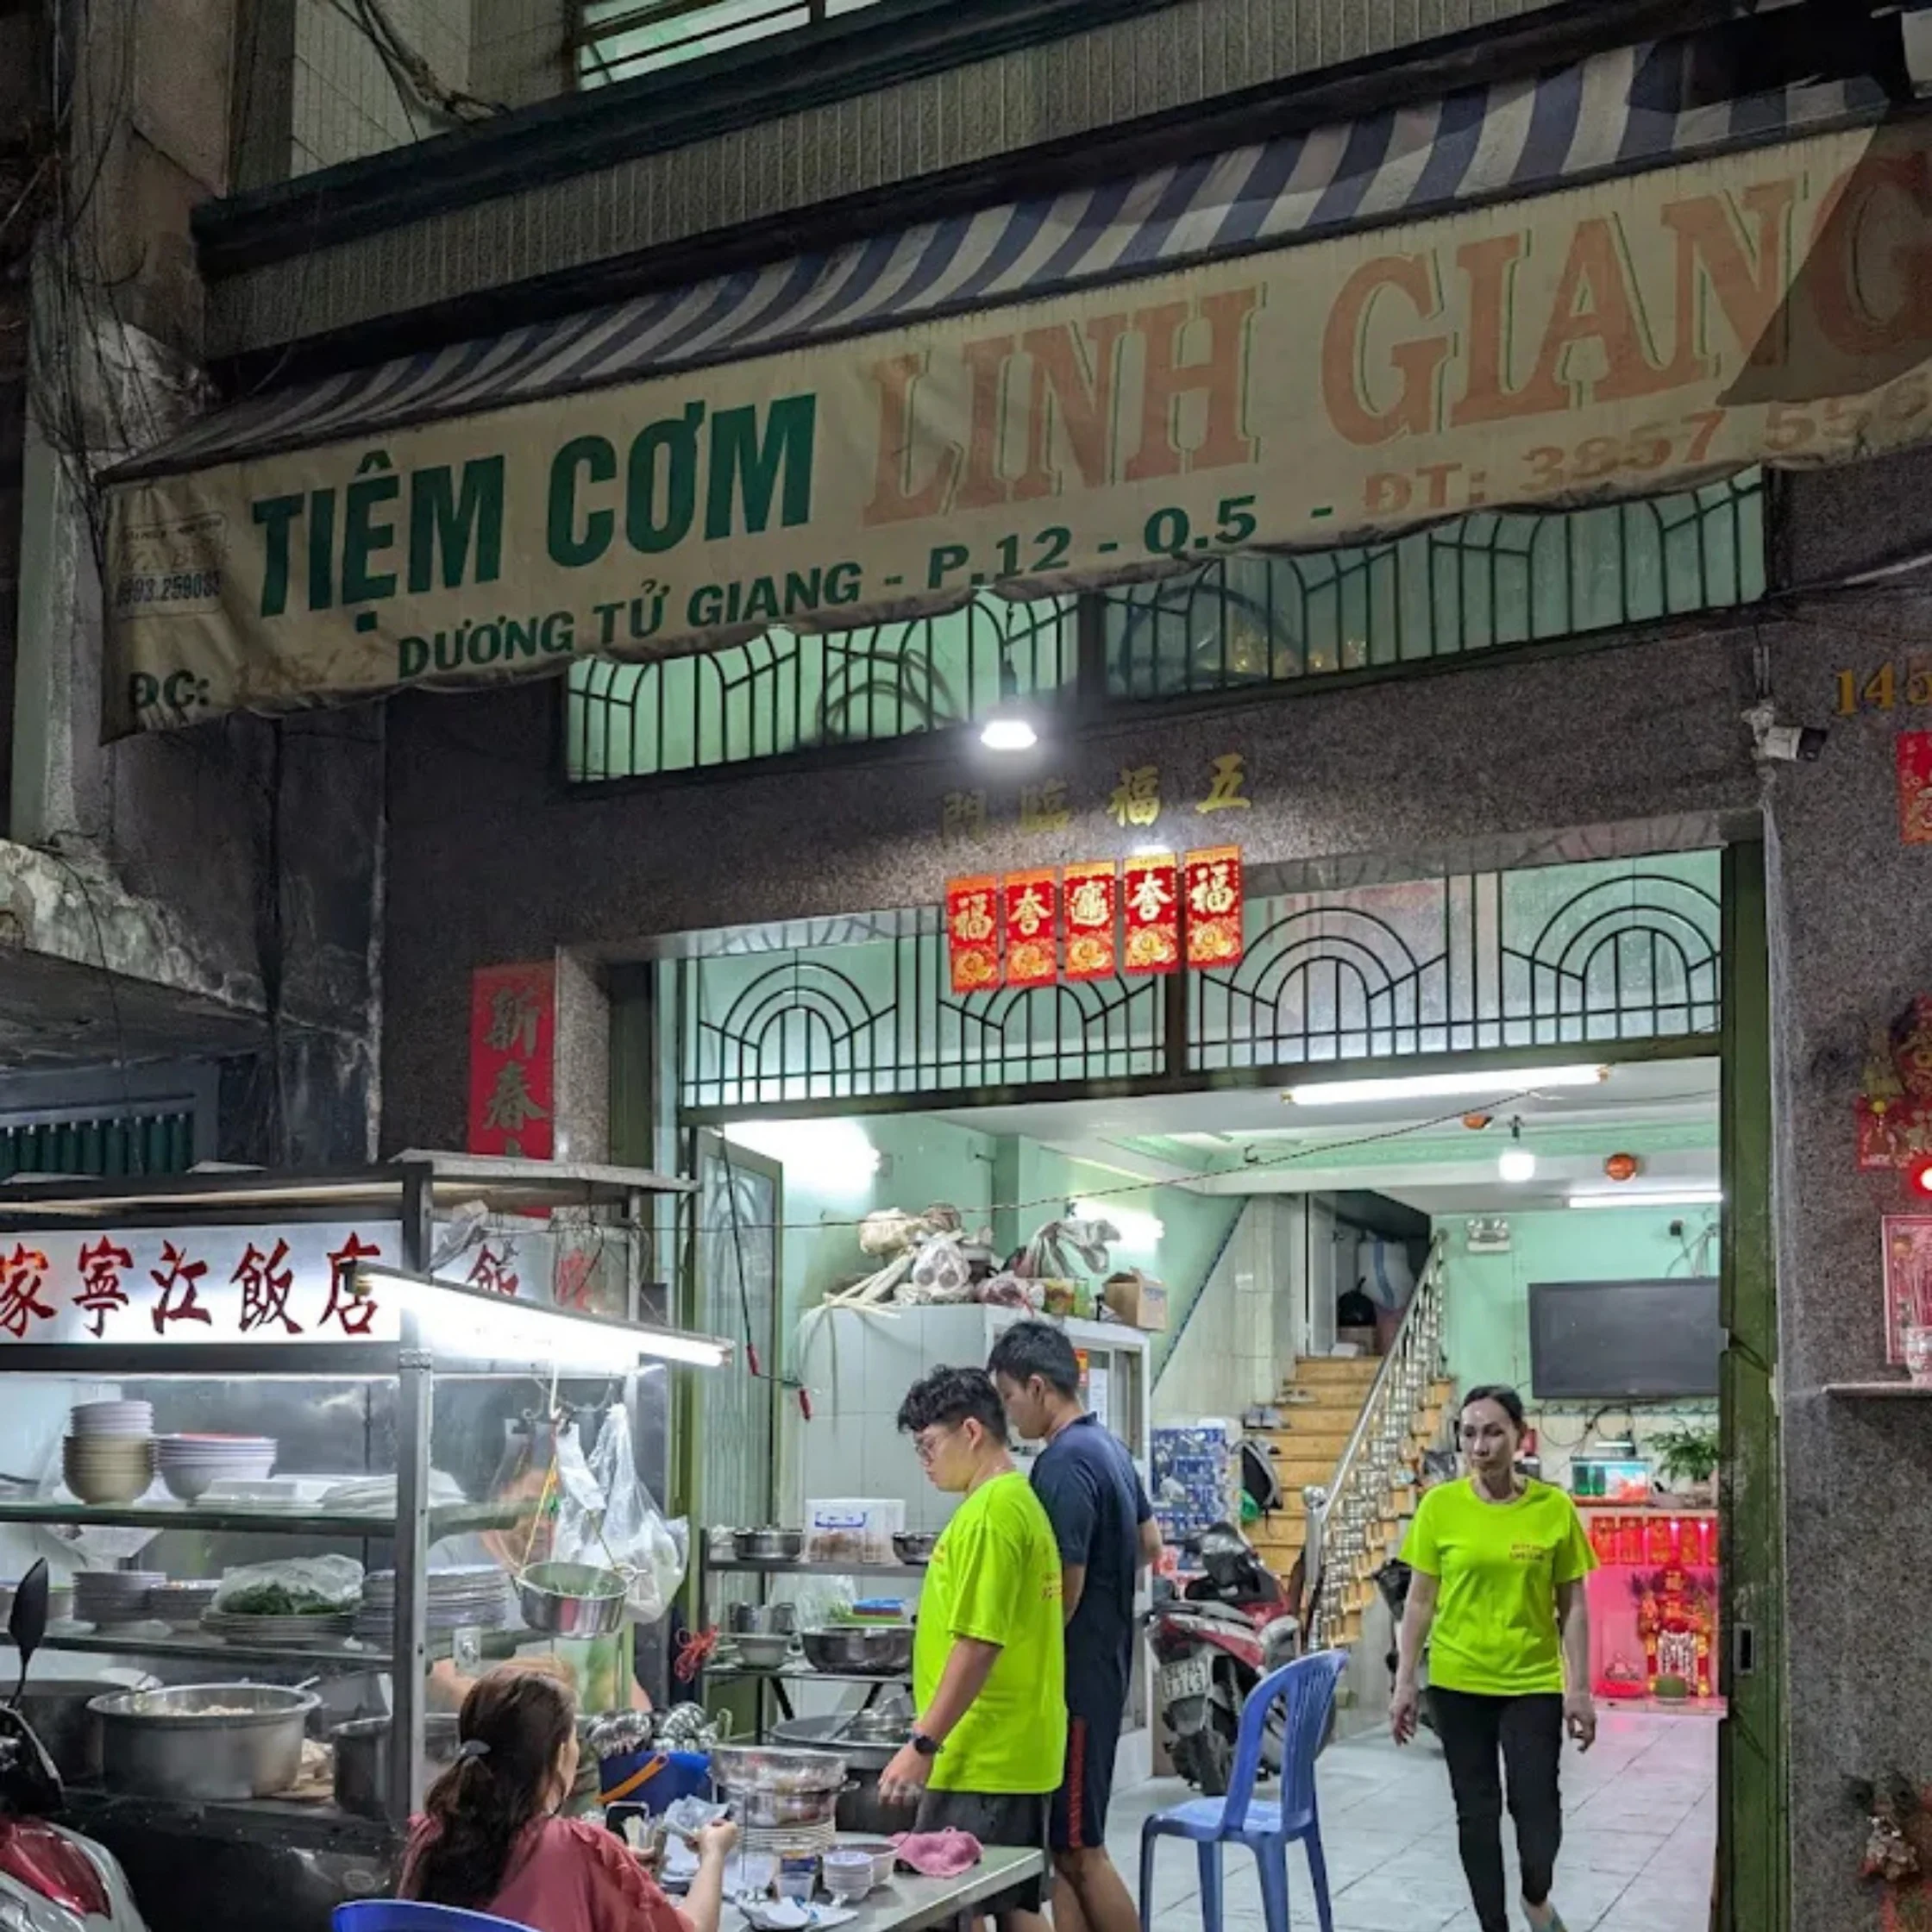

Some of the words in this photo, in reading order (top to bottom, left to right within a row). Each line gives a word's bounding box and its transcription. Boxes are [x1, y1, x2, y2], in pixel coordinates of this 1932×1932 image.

[252, 449, 505, 633] TIỆM
[547, 392, 817, 568] CƠM
[862, 283, 1266, 527] LINH
[1321, 148, 1932, 446] GIANG
[398, 610, 574, 679] DƯƠNG
[592, 577, 672, 644] TỬ
[686, 561, 862, 629] GIANG
[926, 525, 1071, 590] P.12
[1143, 494, 1258, 557] Q.5
[482, 986, 549, 1157] 新春
